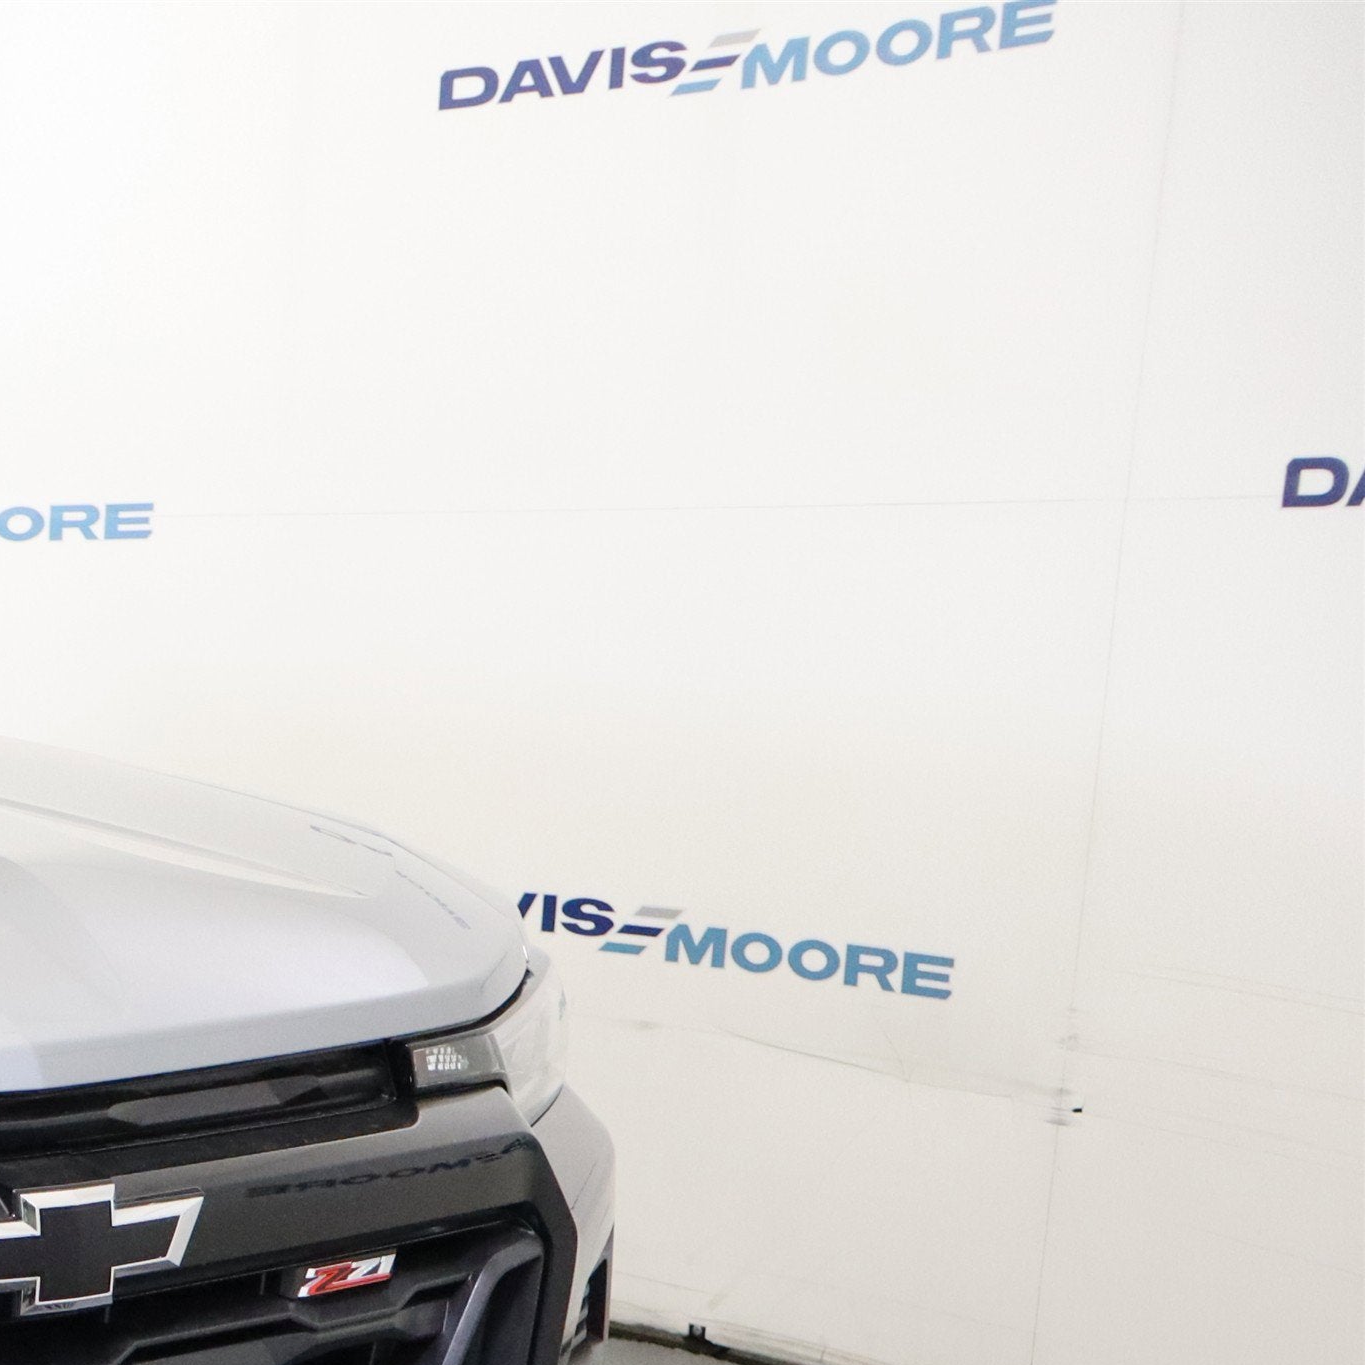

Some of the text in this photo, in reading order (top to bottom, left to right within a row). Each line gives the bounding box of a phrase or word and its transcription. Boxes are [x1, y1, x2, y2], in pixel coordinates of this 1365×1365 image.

[438, 0, 1057, 111] DAVIS MOORE
[664, 922, 955, 1000] MOORE
